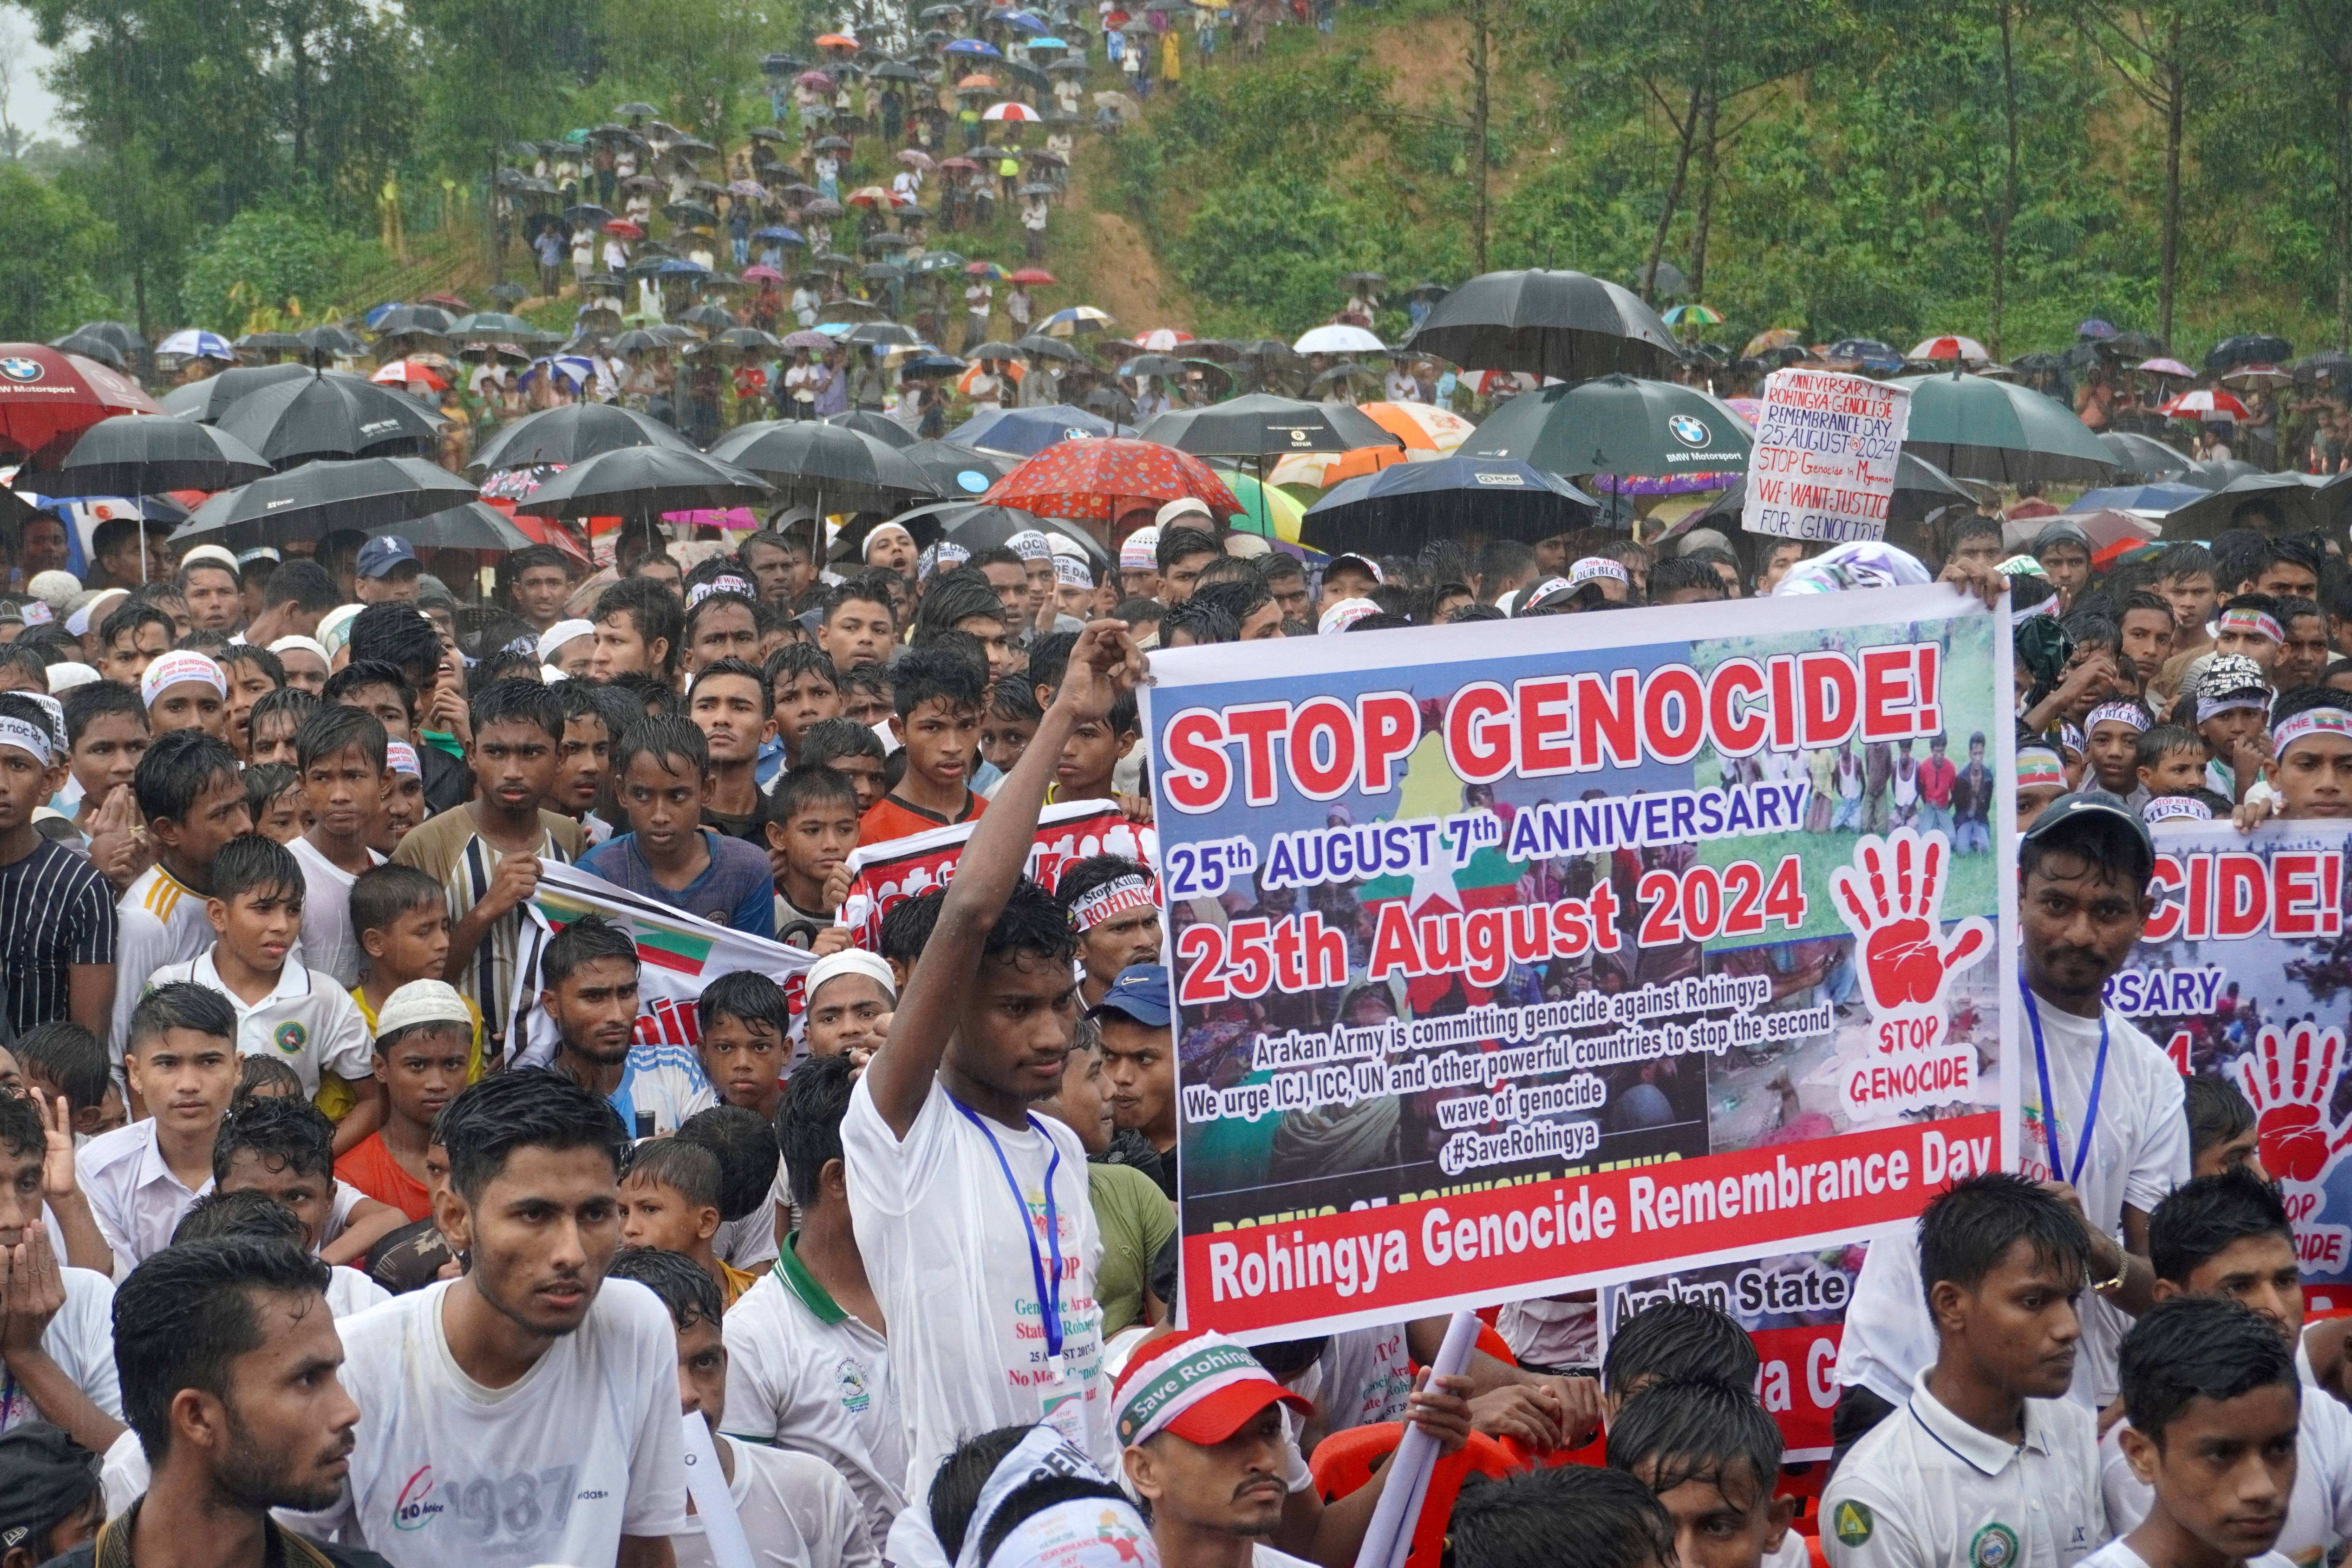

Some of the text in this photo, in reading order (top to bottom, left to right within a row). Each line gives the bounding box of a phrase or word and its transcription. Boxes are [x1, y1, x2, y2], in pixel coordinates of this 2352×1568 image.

[1789, 374, 1872, 398] ANNIVERSARY
[1879, 388, 1896, 400] OF
[1768, 405, 1892, 438] REMEMBRANCE DAY
[1666, 452, 1743, 463] BMW Motorsport
[1061, 575, 1076, 583] 2017
[1072, 568, 1091, 581] DAY
[1576, 568, 1595, 581] OUR
[1585, 560, 1600, 568] 25th
[1341, 609, 1359, 617] STOP
[158, 661, 176, 673] STOP
[1167, 647, 1938, 808] STOP GENOCIDE!
[2284, 718, 2310, 733] THE
[2155, 798, 2205, 811] STOP KILLING
[1172, 784, 1806, 895] 25th AUGUST 7th ANNIVERSARY
[1082, 887, 1152, 928] ROHING
[1084, 884, 1111, 904] Stop
[1180, 858, 1805, 1001] 25th August 2024
[1256, 978, 1767, 1067] Arakan Army is committing genocide against Rohingya
[1878, 1015, 1938, 1053] STOP
[1187, 1007, 1829, 1118] We urge ICJ, ICC, UN and other powerful countries to stop the second
[1849, 1055, 1969, 1104] GENOCIDE
[1442, 1080, 1602, 1124] wave of genocide
[1452, 1124, 1595, 1166] #SaveRohingya
[1209, 1228, 1408, 1301] Rohingya
[1422, 1184, 1616, 1267] Genocide
[1629, 1148, 1908, 1234] Remembrance
[1921, 1131, 1992, 1186] Day
[1739, 1273, 1846, 1311] State
[1030, 1352, 1040, 1363] 25
[1008, 1370, 1029, 1386] No
[1134, 1380, 1179, 1419] Save
